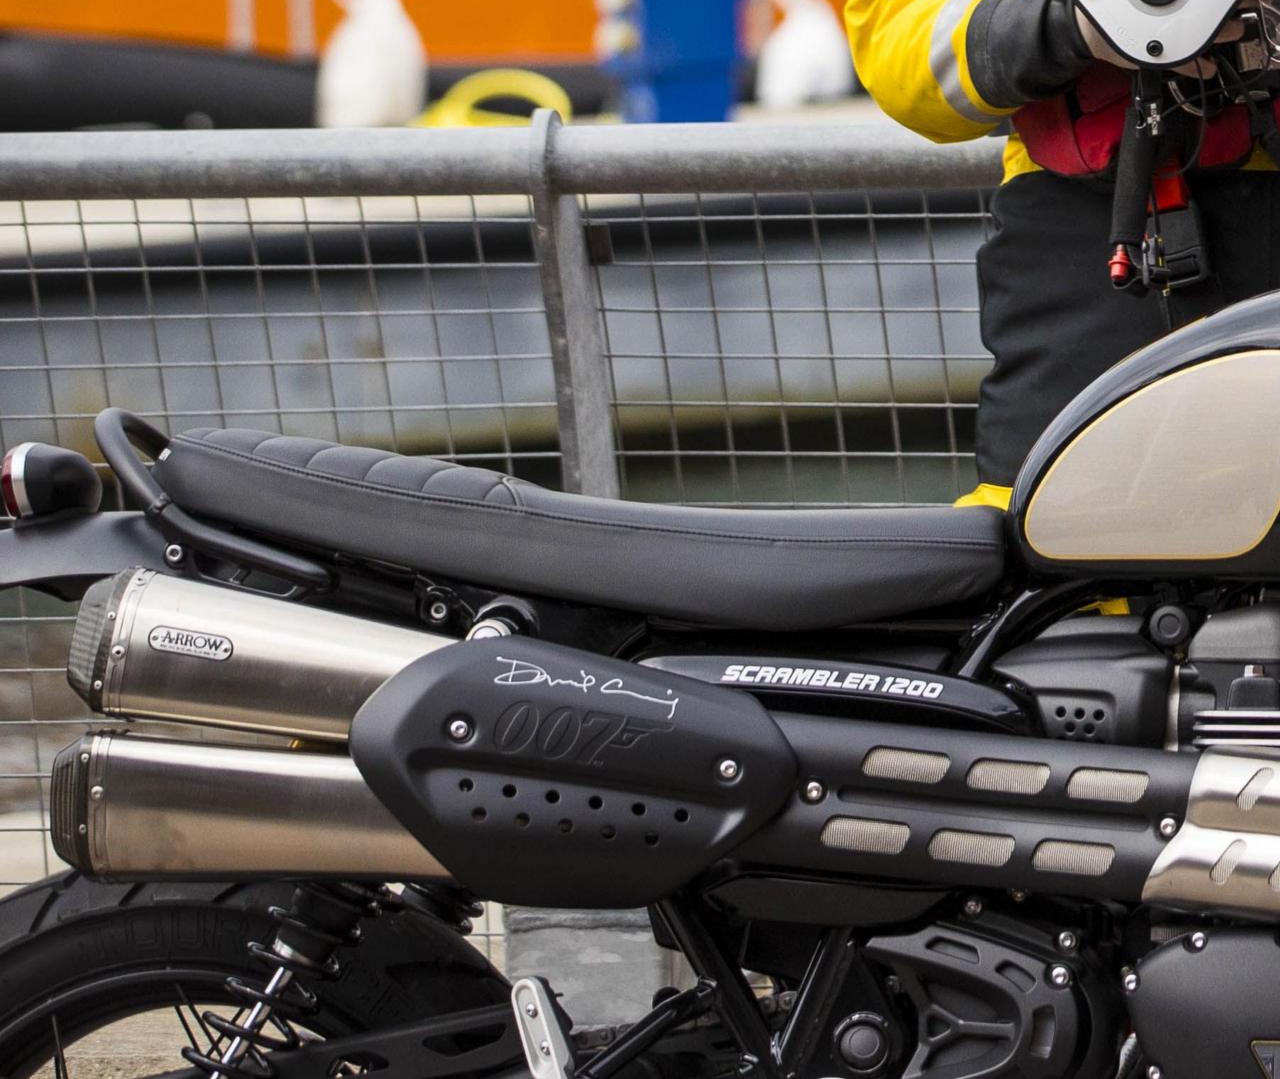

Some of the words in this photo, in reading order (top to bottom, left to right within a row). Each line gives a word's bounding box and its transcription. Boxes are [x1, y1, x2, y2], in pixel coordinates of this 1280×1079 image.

[161, 630, 223, 652] ARROW
[721, 664, 880, 691] SCRAMBLER
[881, 676, 944, 699] 1200
[493, 700, 627, 765] 007
